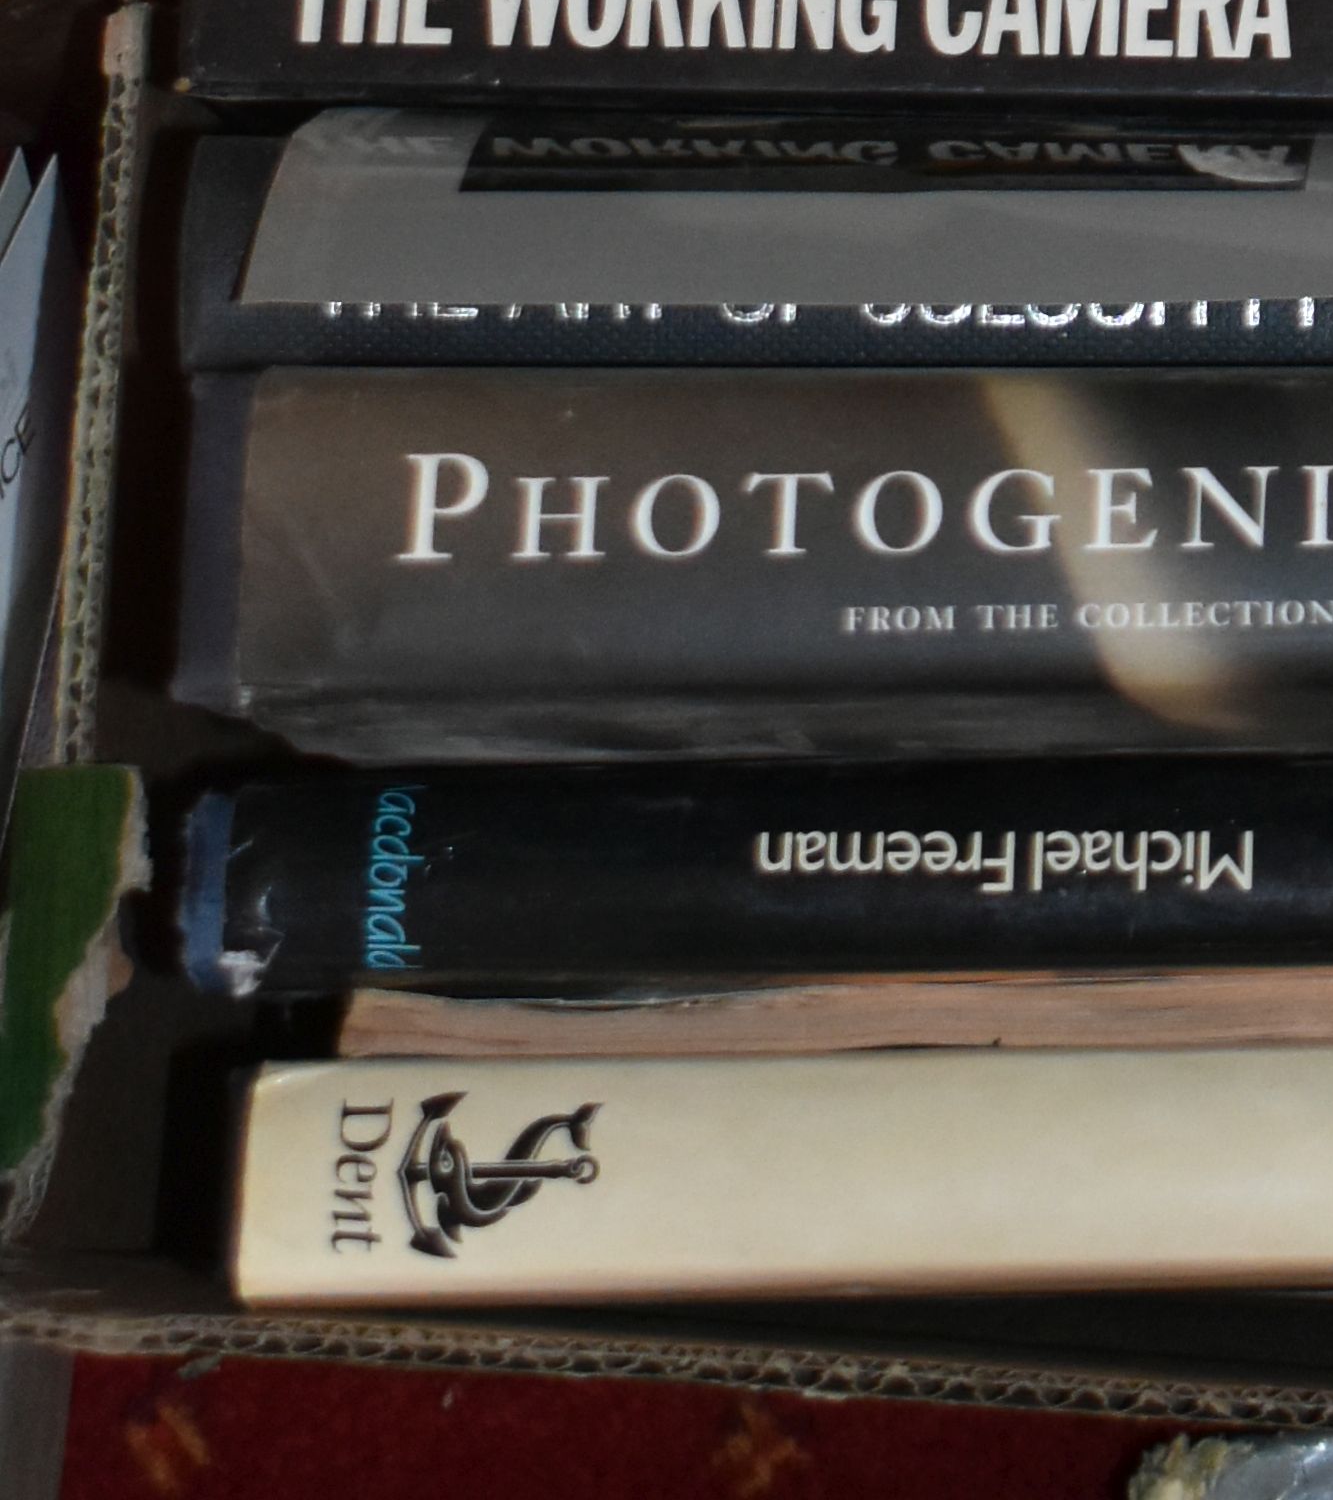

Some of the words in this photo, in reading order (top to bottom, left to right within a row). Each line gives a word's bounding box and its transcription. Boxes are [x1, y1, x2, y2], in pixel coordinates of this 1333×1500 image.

[843, 602, 957, 632] FROM
[973, 602, 1060, 630] THE
[757, 830, 1015, 894] Freeman
[1032, 828, 1253, 893] Michael
[330, 1097, 394, 1256] Dent
